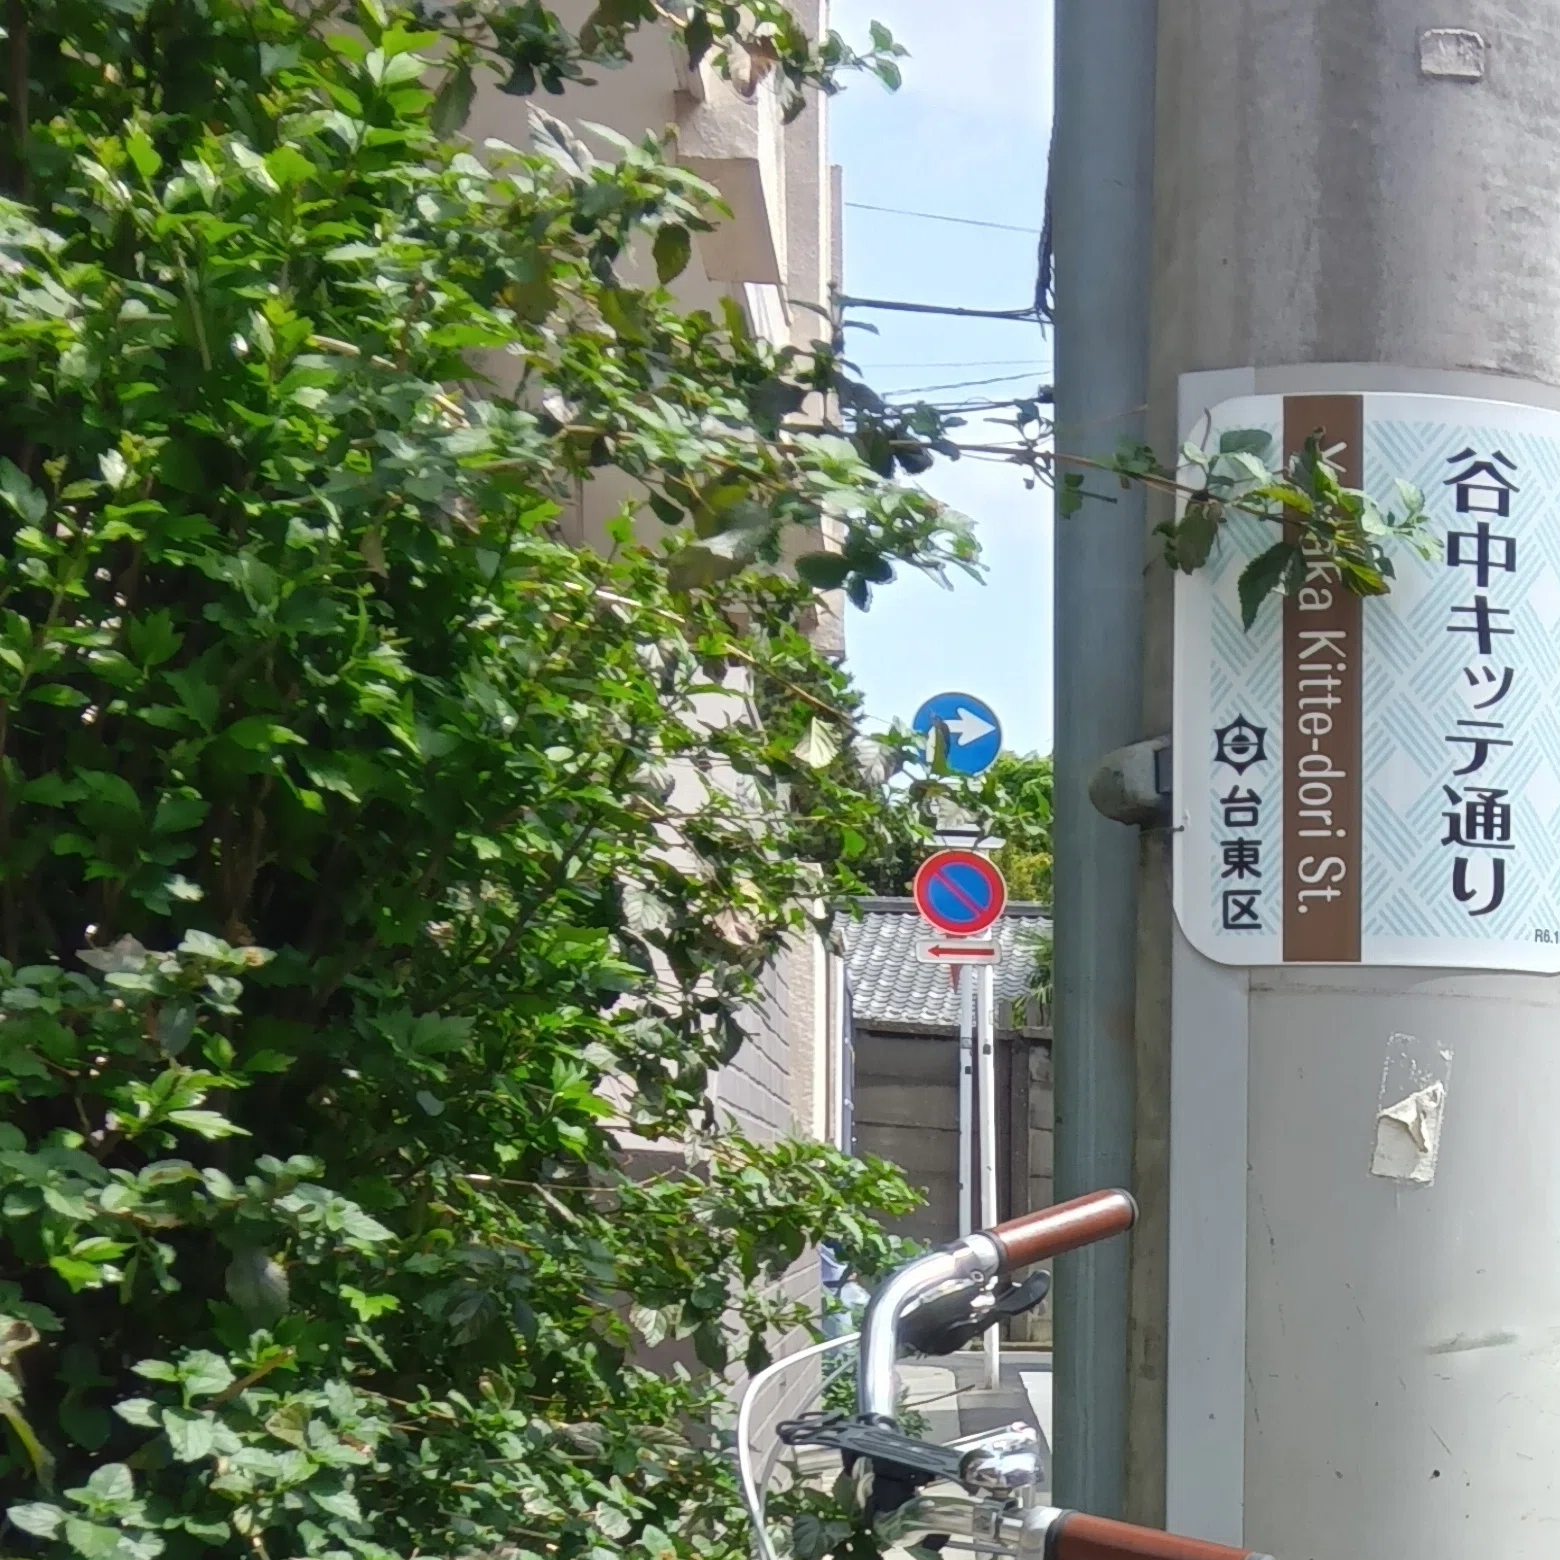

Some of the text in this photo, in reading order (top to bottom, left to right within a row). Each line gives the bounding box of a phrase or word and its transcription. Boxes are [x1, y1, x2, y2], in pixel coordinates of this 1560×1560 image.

[1219, 784, 1263, 930] 台東区
[1297, 441, 1348, 914] Yaka Kitte-dori St.
[1441, 446, 1521, 917] 谷中キッテ通り
